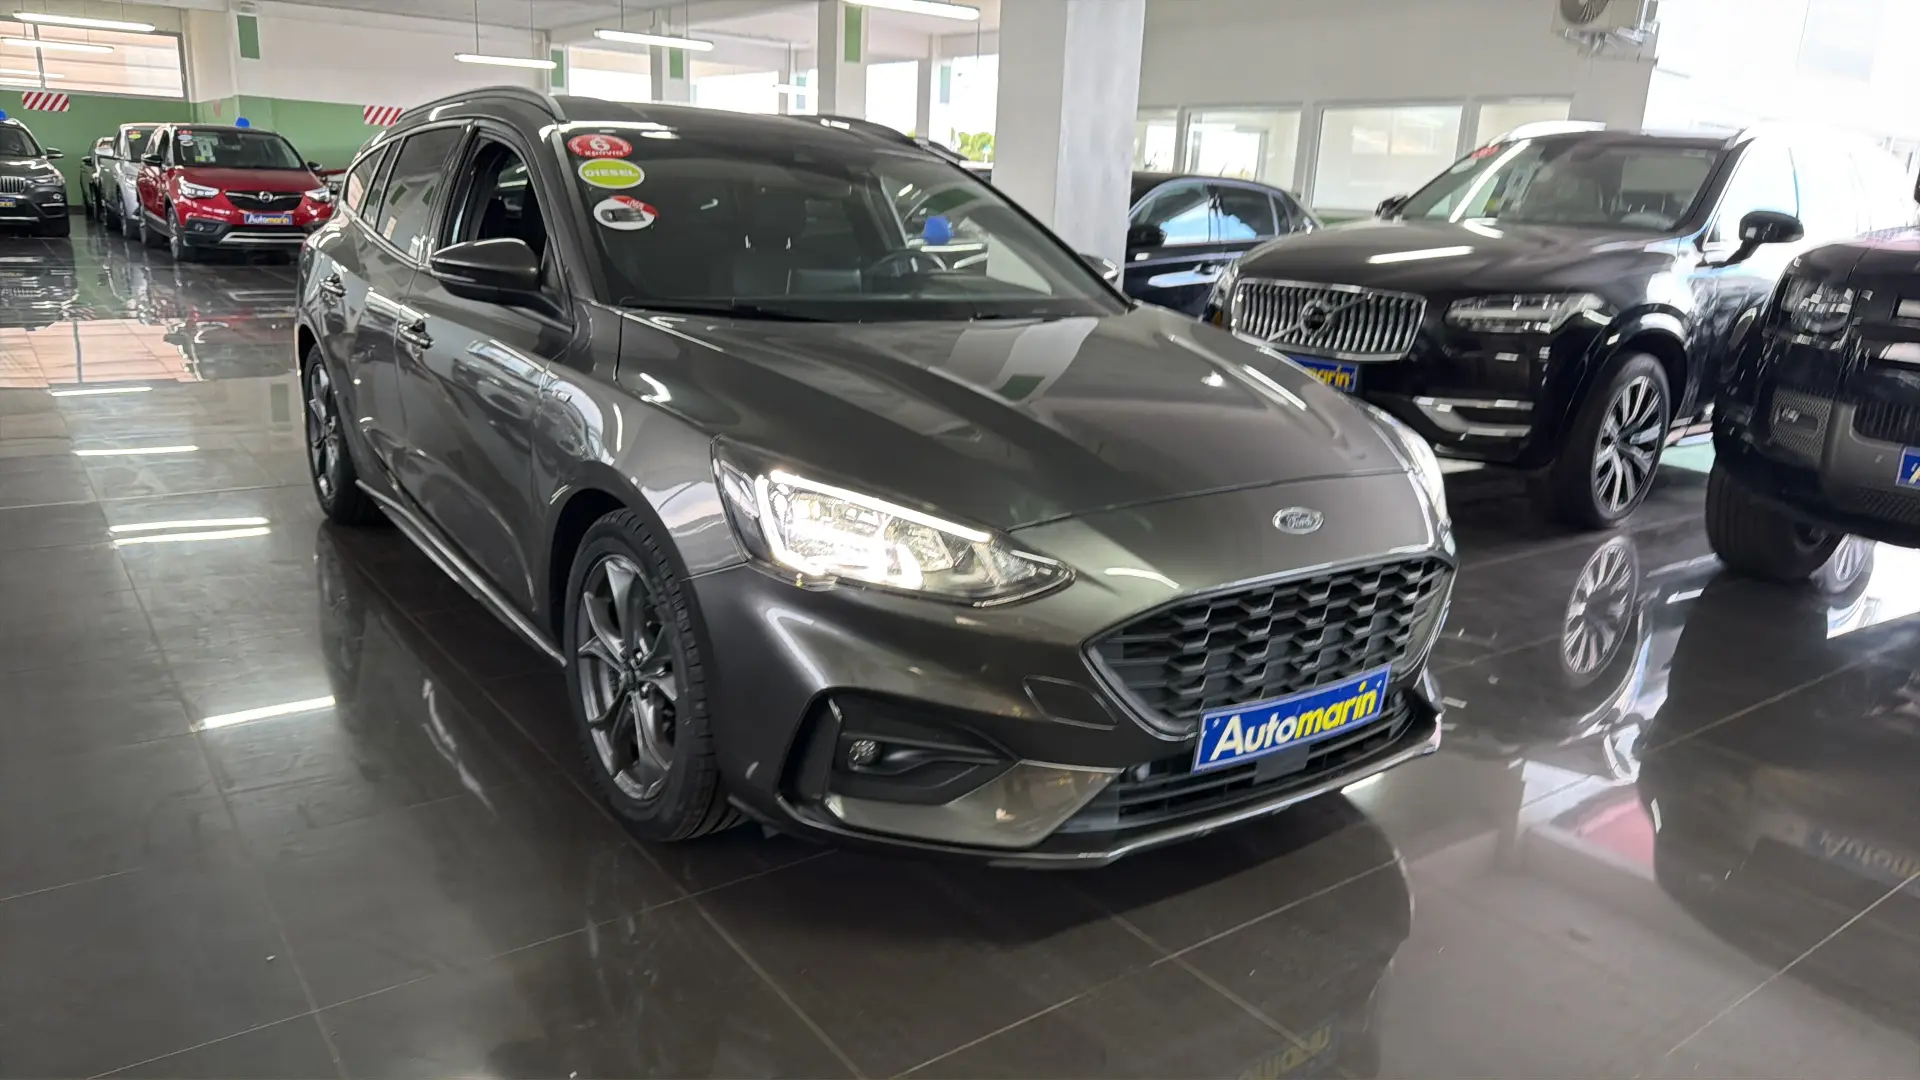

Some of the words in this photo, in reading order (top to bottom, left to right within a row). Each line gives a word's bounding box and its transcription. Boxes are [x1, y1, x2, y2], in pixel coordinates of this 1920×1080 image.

[584, 168, 639, 178] DIESEL
[247, 213, 290, 225] Automarin
[1208, 680, 1378, 762] Automarin
